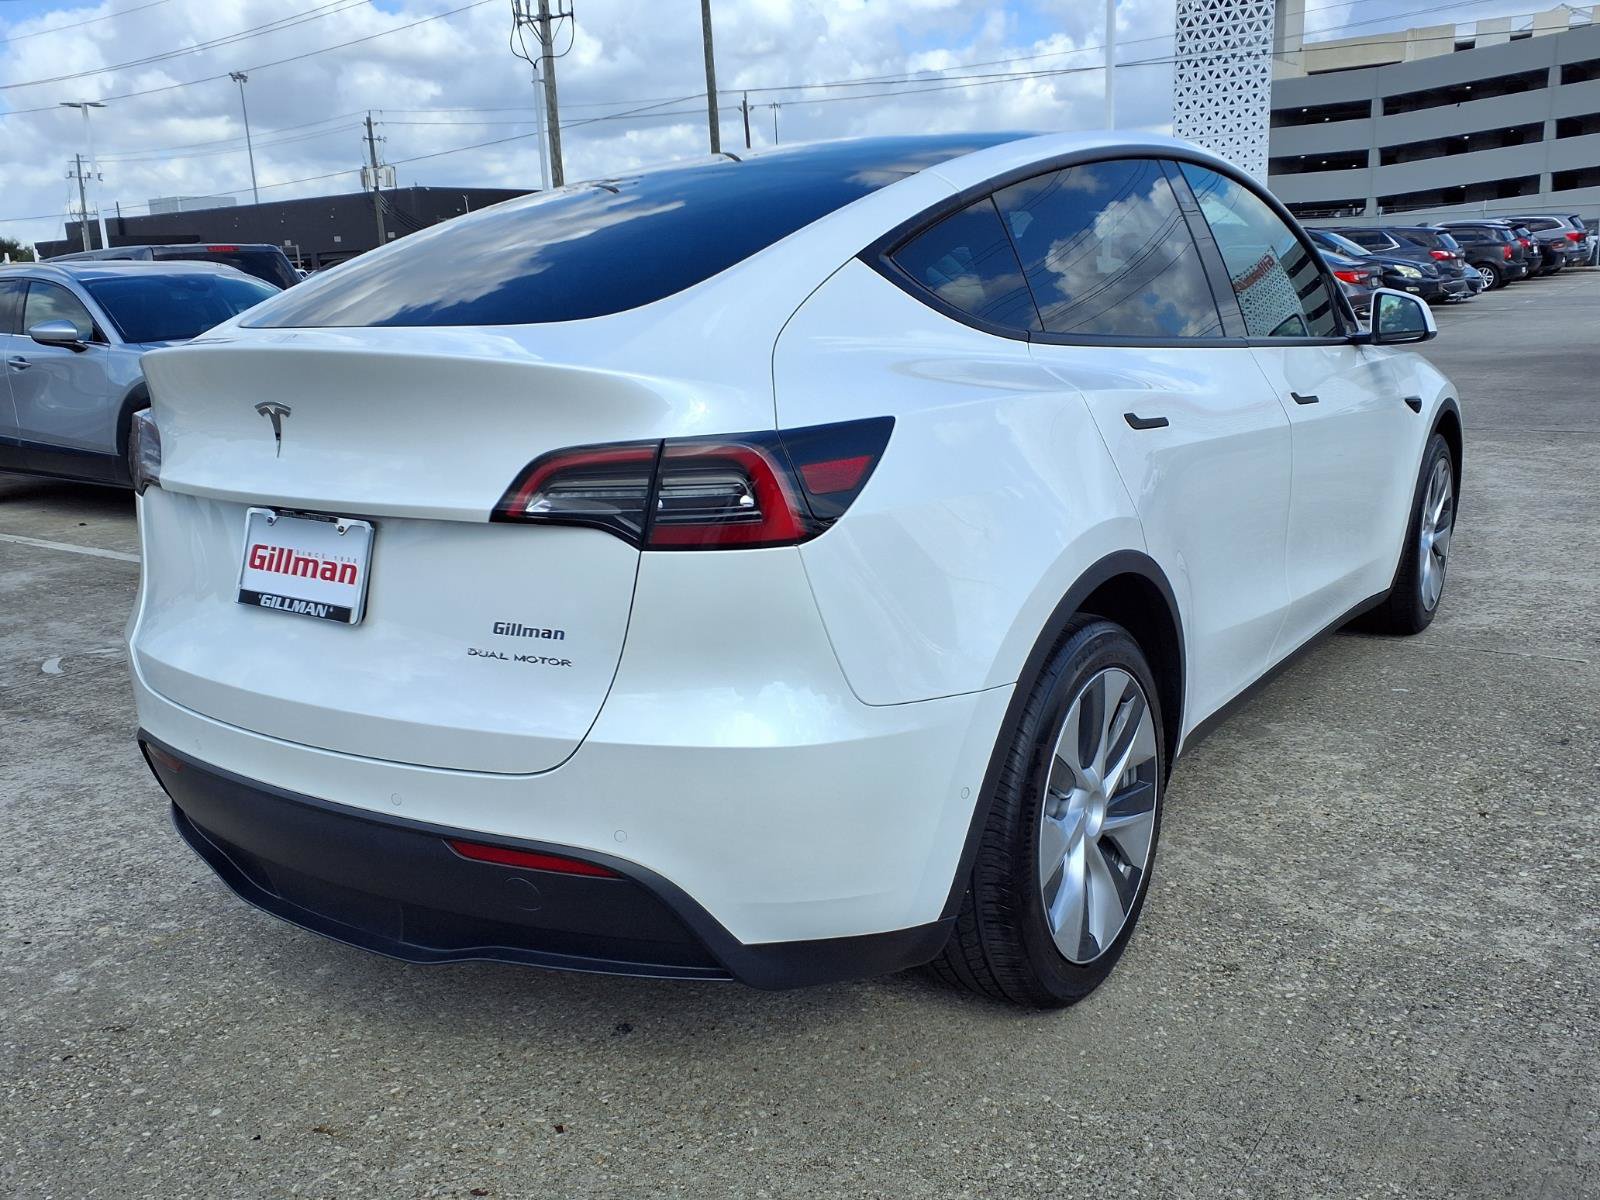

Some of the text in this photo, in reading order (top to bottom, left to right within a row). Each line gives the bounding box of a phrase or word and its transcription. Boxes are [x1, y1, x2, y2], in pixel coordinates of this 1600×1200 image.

[249, 543, 358, 585] Gillman
[260, 594, 328, 617] GILLMAN
[493, 621, 565, 640] Gillman
[467, 647, 572, 667] DUAL MOTOR
